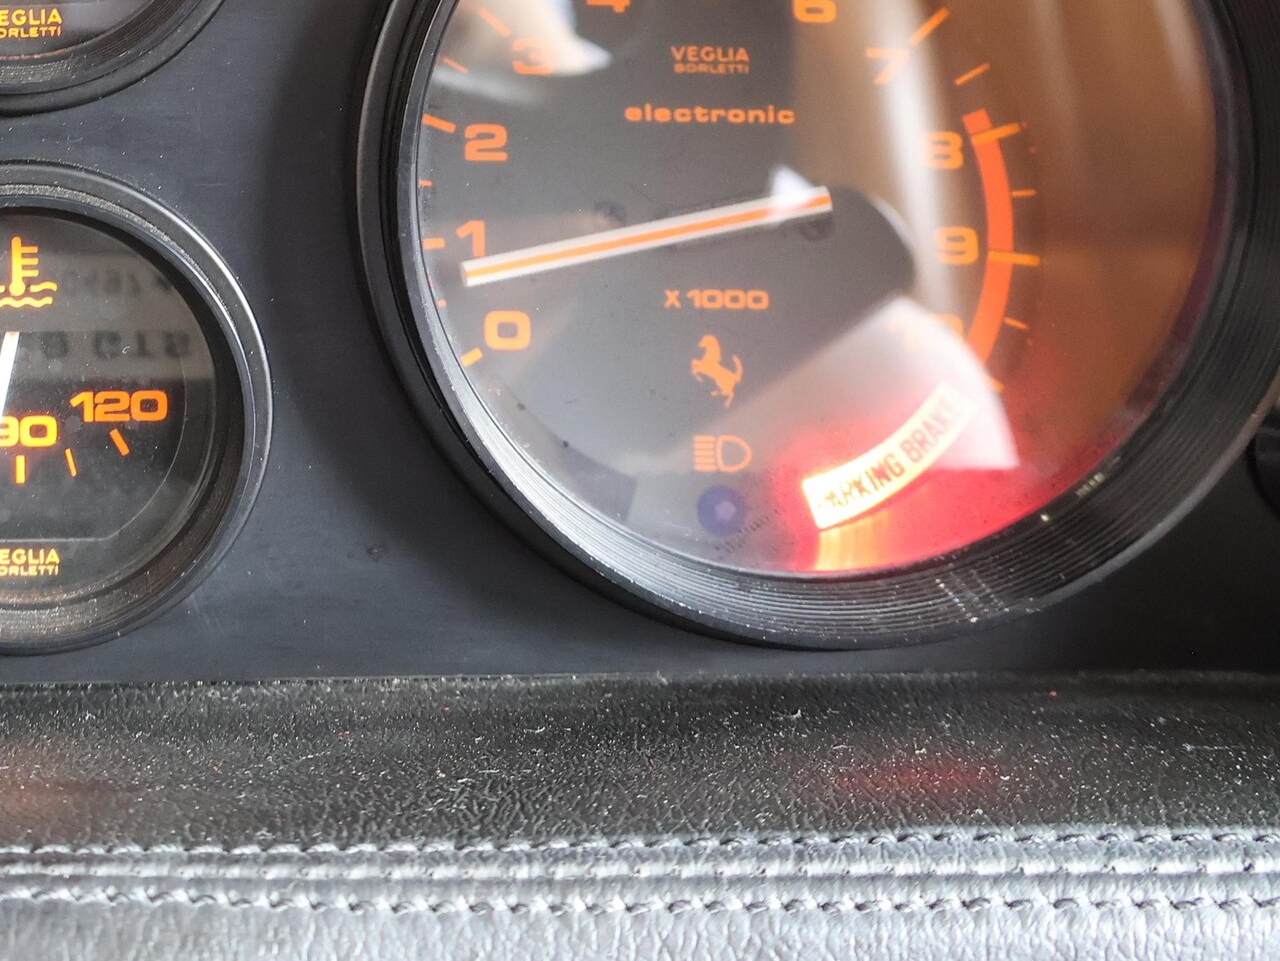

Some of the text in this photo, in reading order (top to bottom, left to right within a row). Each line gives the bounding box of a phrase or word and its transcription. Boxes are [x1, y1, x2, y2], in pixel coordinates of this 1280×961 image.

[512, 39, 556, 77] 3
[671, 46, 750, 63] VEGLIA
[673, 63, 750, 74] BORLETTI
[864, 48, 910, 85] 7
[624, 103, 795, 124] electronic
[464, 124, 508, 162] 2
[921, 132, 964, 170] 8
[456, 219, 485, 257] 1
[934, 225, 978, 266] 9
[686, 288, 769, 310] 1000
[484, 310, 531, 351] 0
[69, 389, 168, 423] 120
[816, 452, 905, 513] ARKING
